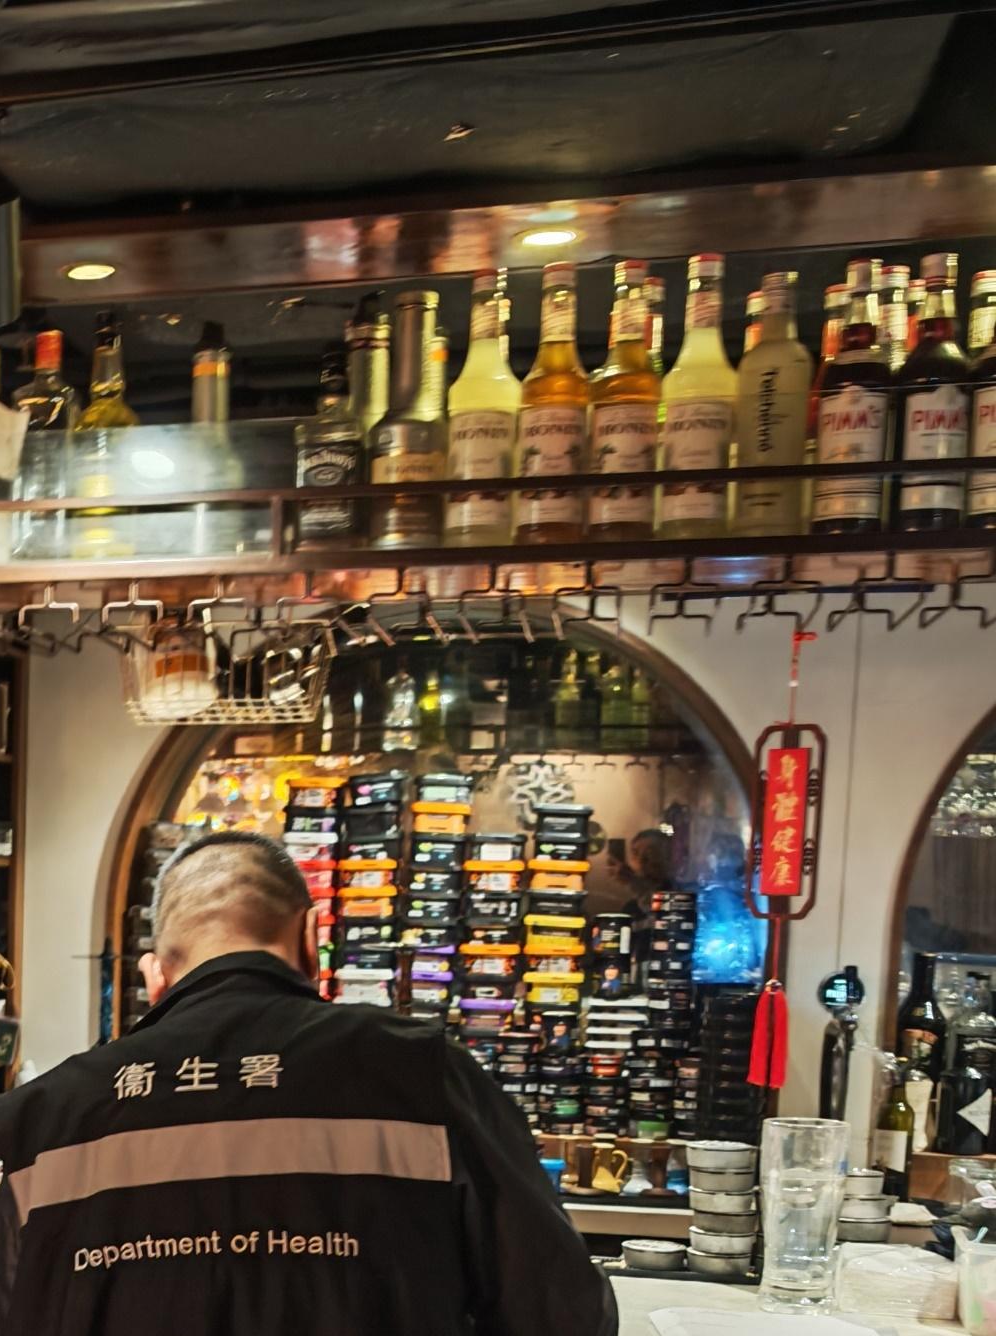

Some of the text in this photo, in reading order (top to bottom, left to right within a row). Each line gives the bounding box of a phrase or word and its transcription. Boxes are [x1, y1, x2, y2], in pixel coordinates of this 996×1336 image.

[74, 1229, 359, 1271] Department of Health
